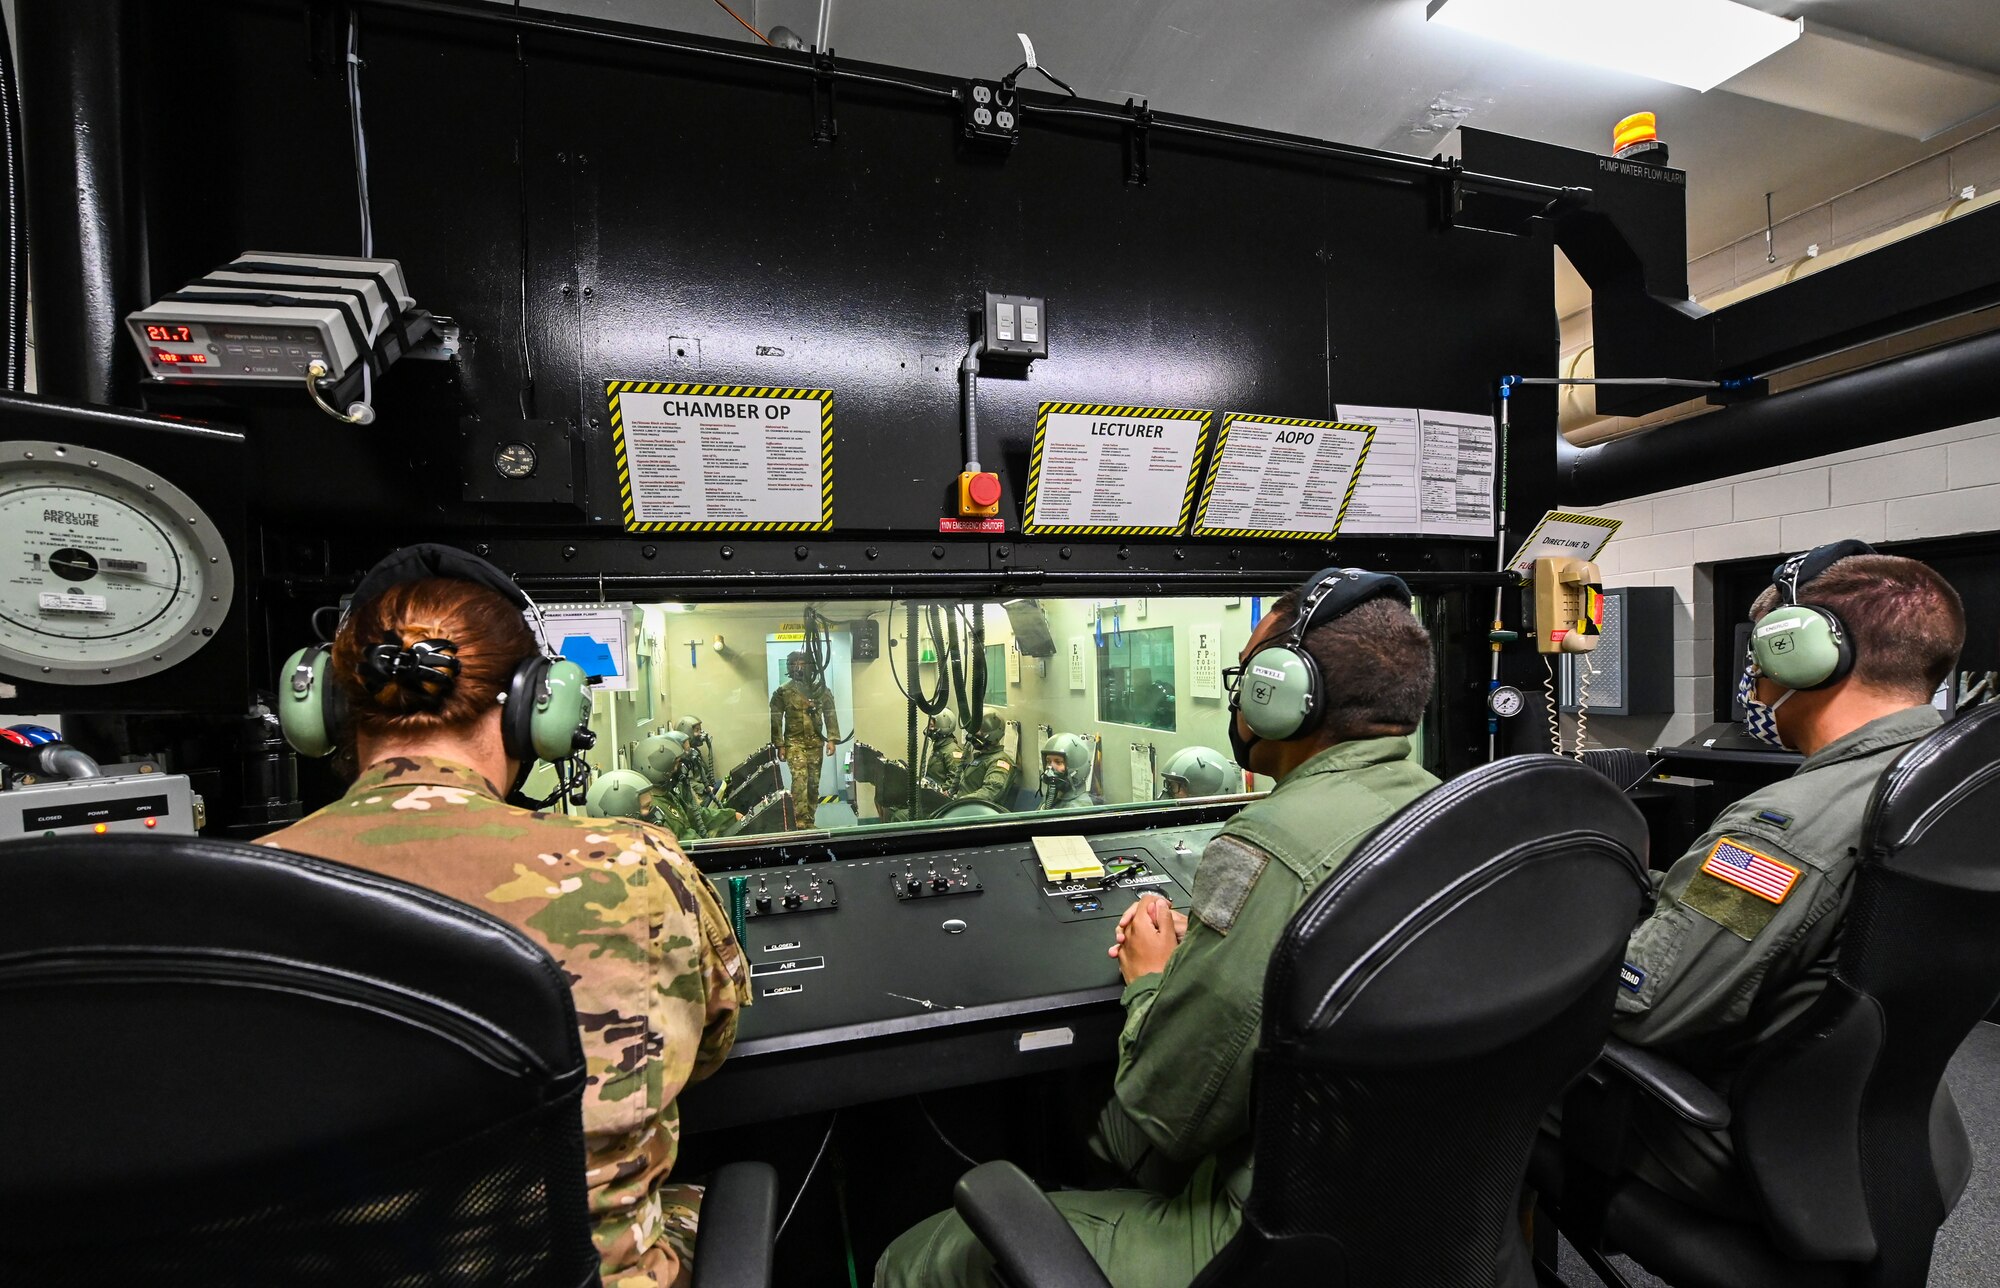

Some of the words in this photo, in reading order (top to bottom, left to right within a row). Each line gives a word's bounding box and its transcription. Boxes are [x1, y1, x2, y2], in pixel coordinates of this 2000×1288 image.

[1600, 159, 1618, 172] PUMP
[1620, 163, 1643, 178] WATER
[1644, 168, 1662, 180] FLOW
[1664, 170, 1684, 184] ALARM
[147, 326, 190, 341] 21.7
[663, 401, 760, 419] CHAMBER
[765, 405, 790, 420] OP
[1091, 422, 1164, 438] LECTURER
[1275, 430, 1314, 445] AOPO
[44, 509, 100, 520] ABSOLUTE
[44, 516, 100, 527] PRESSURE
[953, 521, 981, 530] EMERGENCY
[982, 521, 1003, 530] SHUTOFF
[1542, 536, 1565, 546] DIRECT
[1565, 539, 1580, 548] LINE
[1518, 562, 1534, 570] FLIG
[1200, 634, 1207, 648] E
[1256, 668, 1281, 678] POWELL
[1124, 875, 1163, 885] CHAMBER
[1059, 884, 1088, 892] LOCK
[780, 962, 796, 970] AIR
